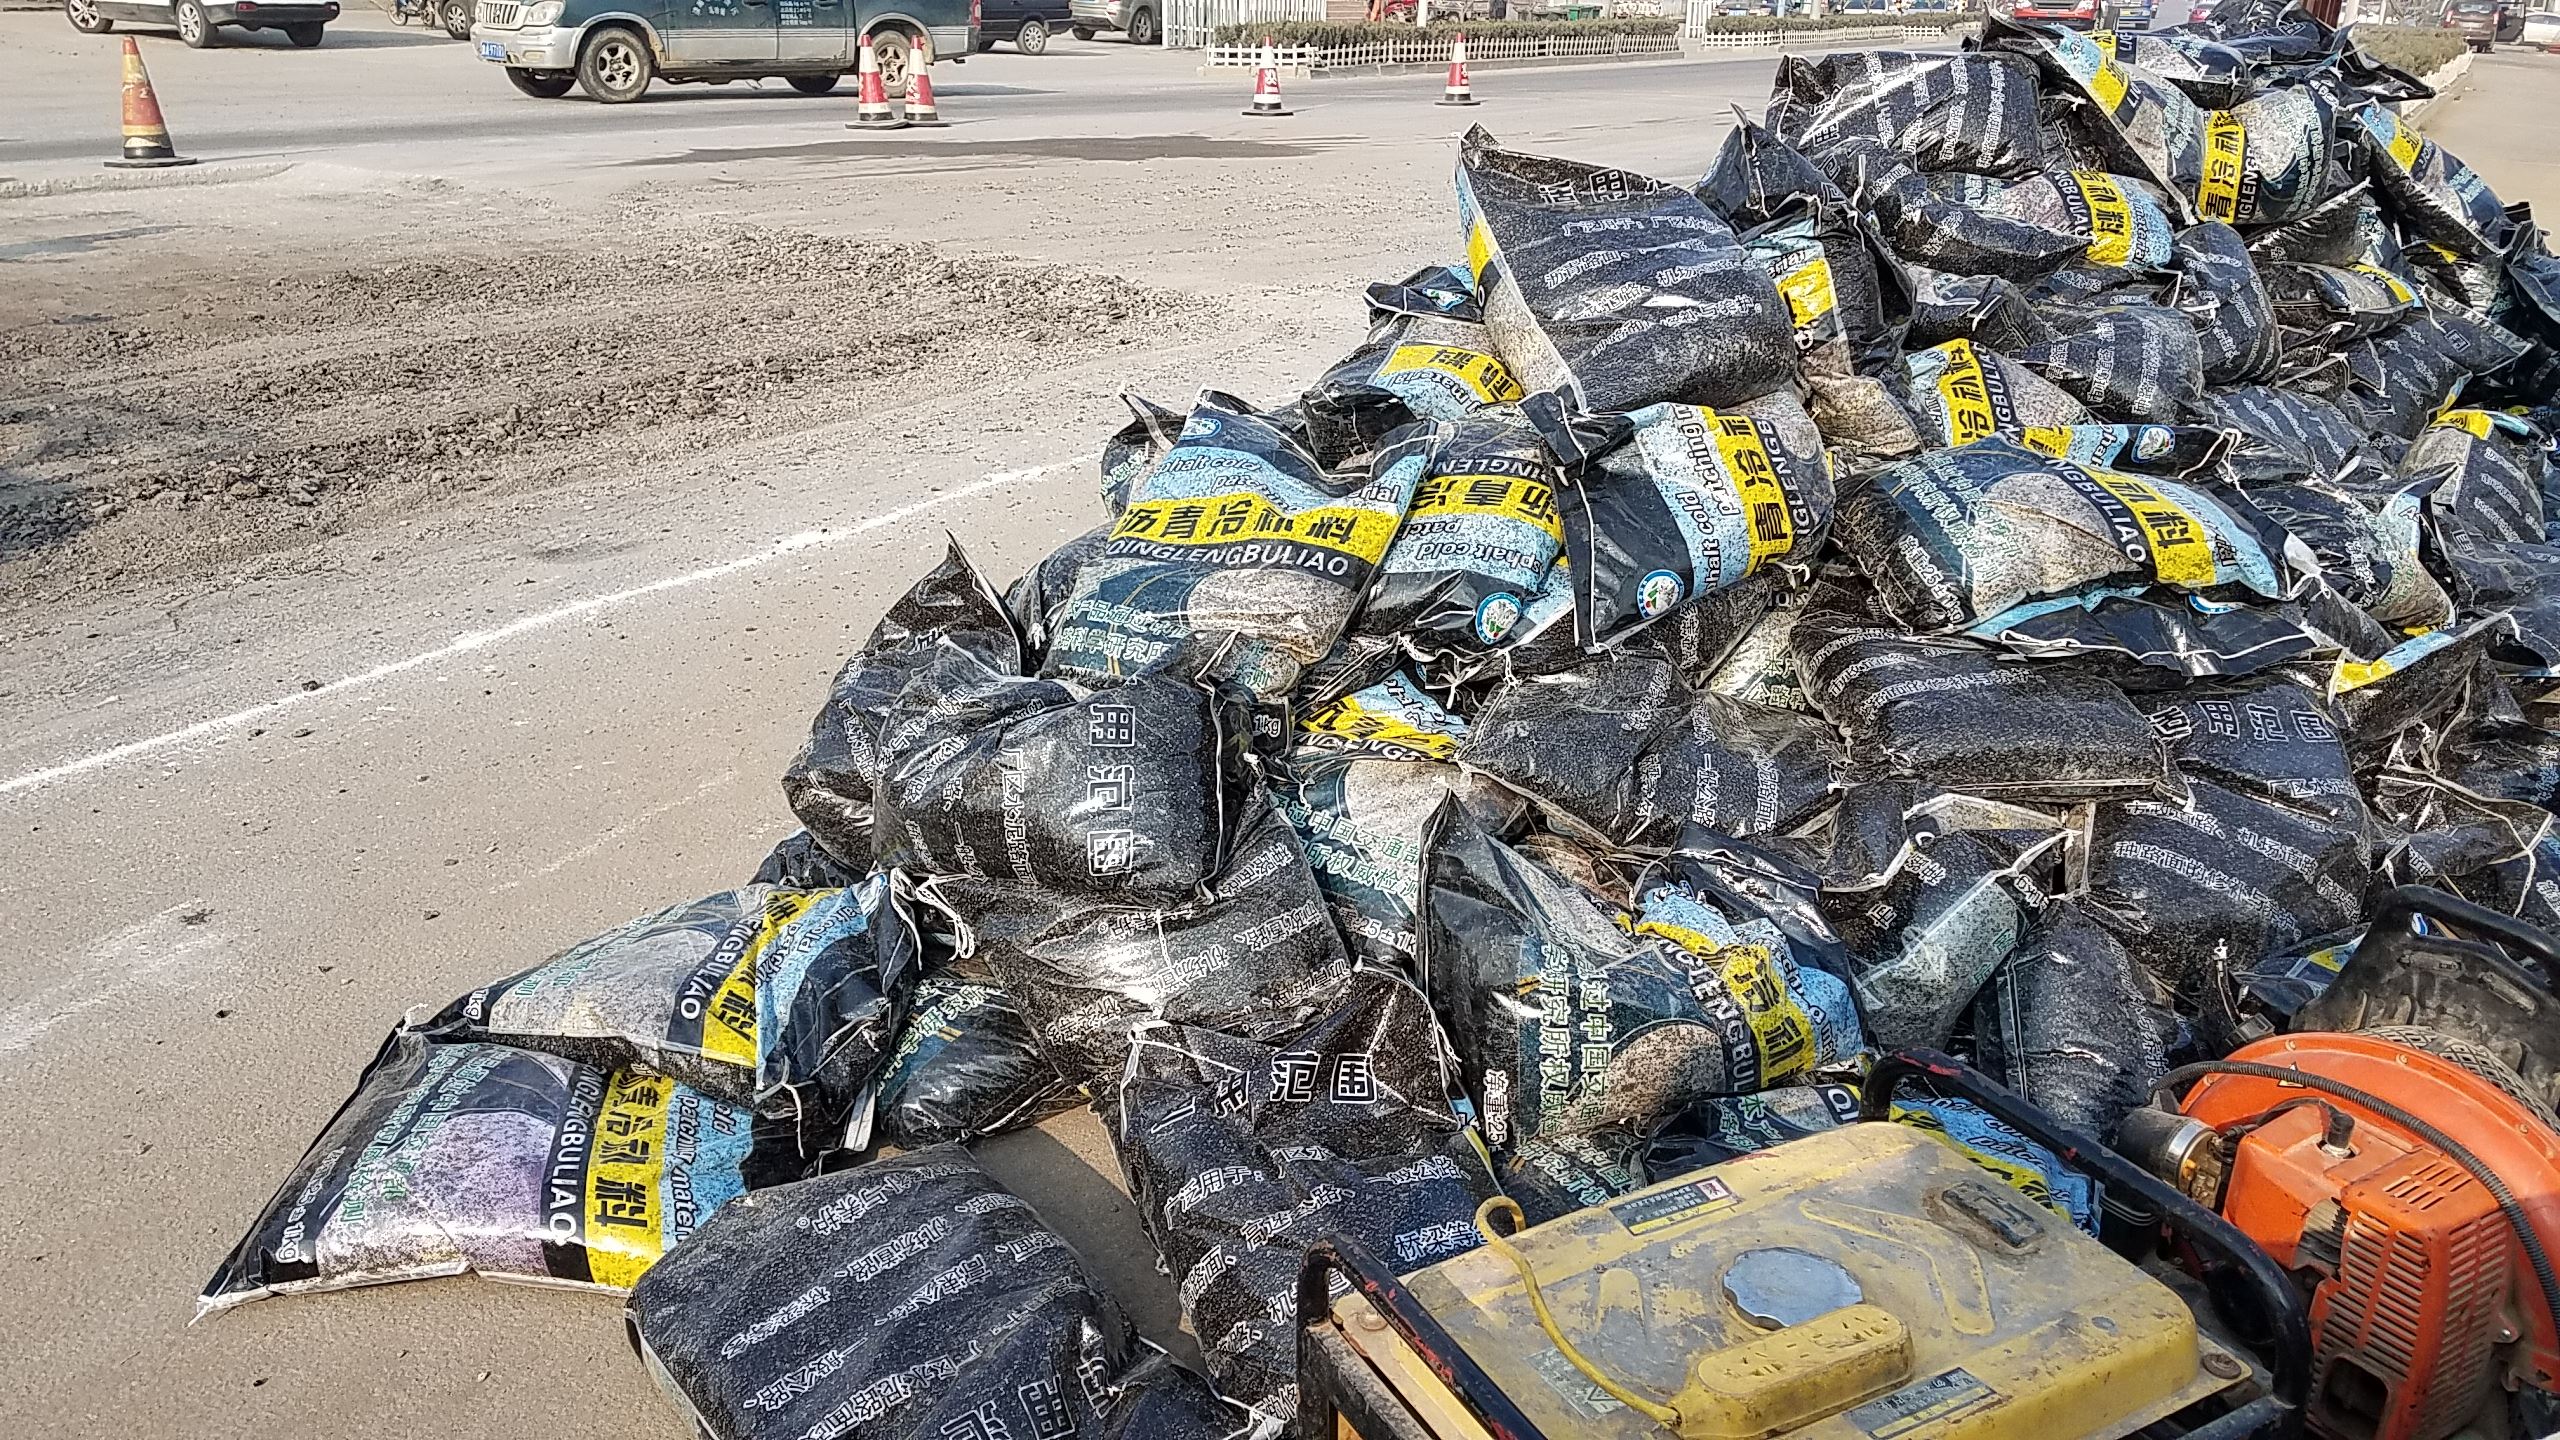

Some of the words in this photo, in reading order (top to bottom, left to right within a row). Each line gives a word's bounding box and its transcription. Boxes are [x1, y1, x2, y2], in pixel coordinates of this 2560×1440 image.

[1681, 422, 1740, 517] patching
[1113, 498, 1360, 547] 沥青冷补料
[1675, 490, 1714, 535] cold
[2045, 459, 2147, 563] NGBULIAO
[1416, 542, 1470, 561] cold
[1150, 1051, 1378, 1135] 用范围
[1163, 1166, 1264, 1231] 广泛用于:
